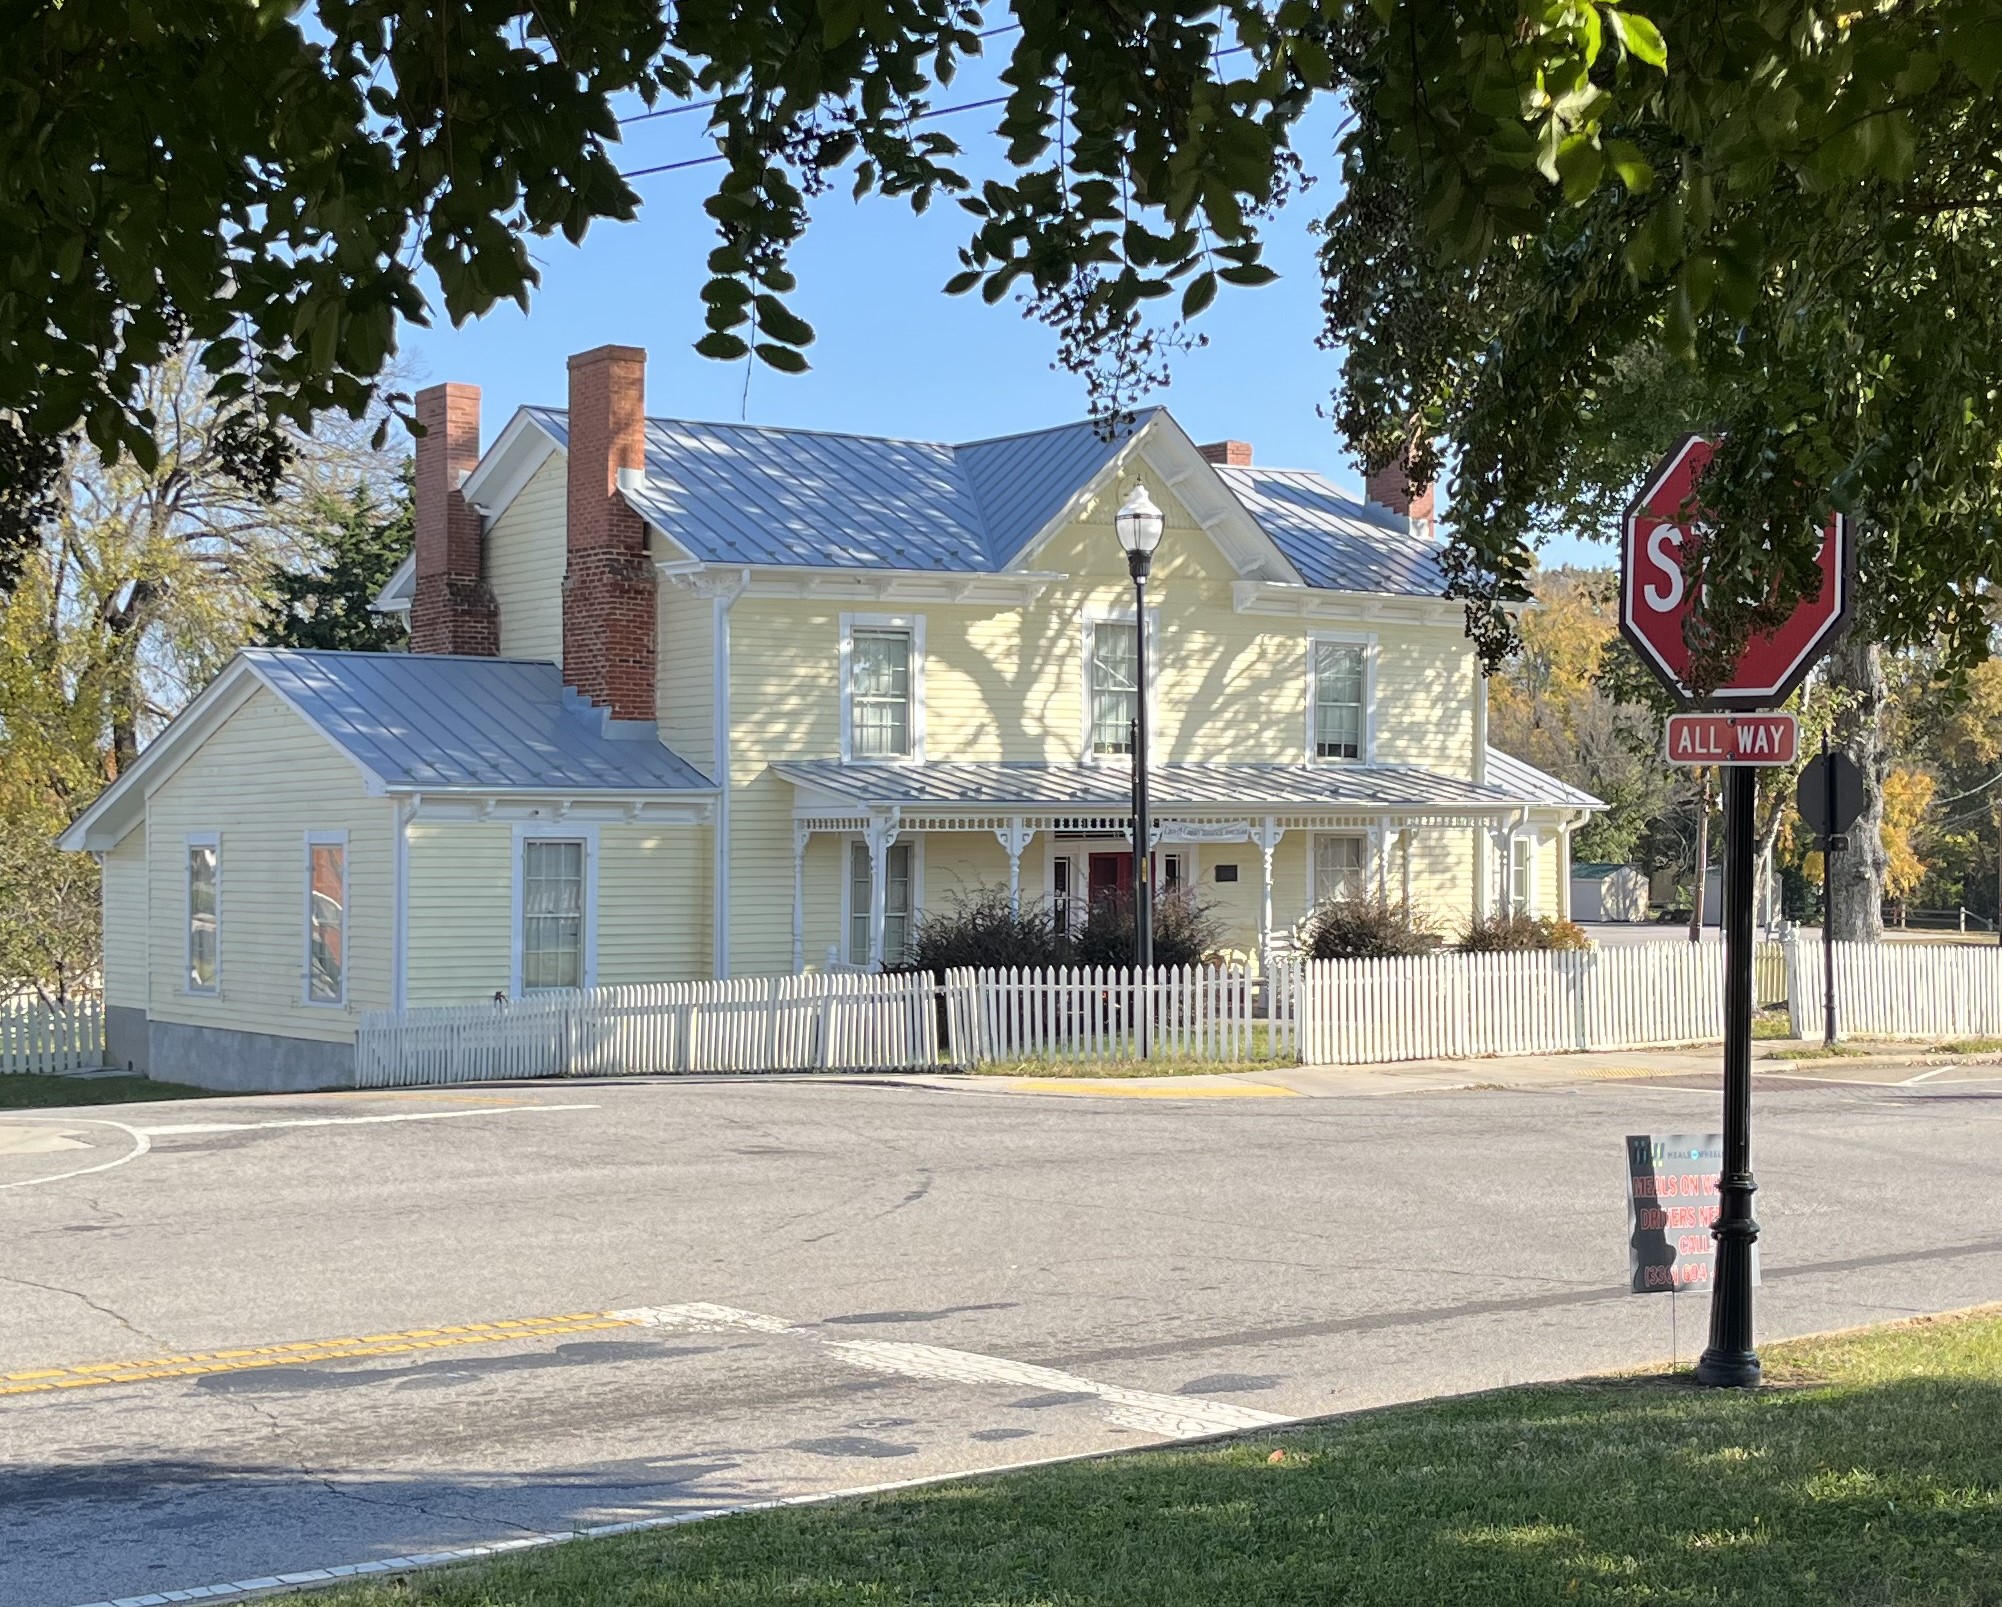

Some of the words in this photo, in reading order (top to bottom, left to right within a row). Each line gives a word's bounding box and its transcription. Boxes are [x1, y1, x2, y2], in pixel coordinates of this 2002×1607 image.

[1677, 726, 1722, 754] ALL
[1736, 725, 1785, 754] WAY
[1699, 1150, 1722, 1159] WHEEL
[1633, 1175, 1678, 1198] MEALS
[1679, 1175, 1700, 1197] ON
[1640, 1205, 1697, 1230] DRIVERS
